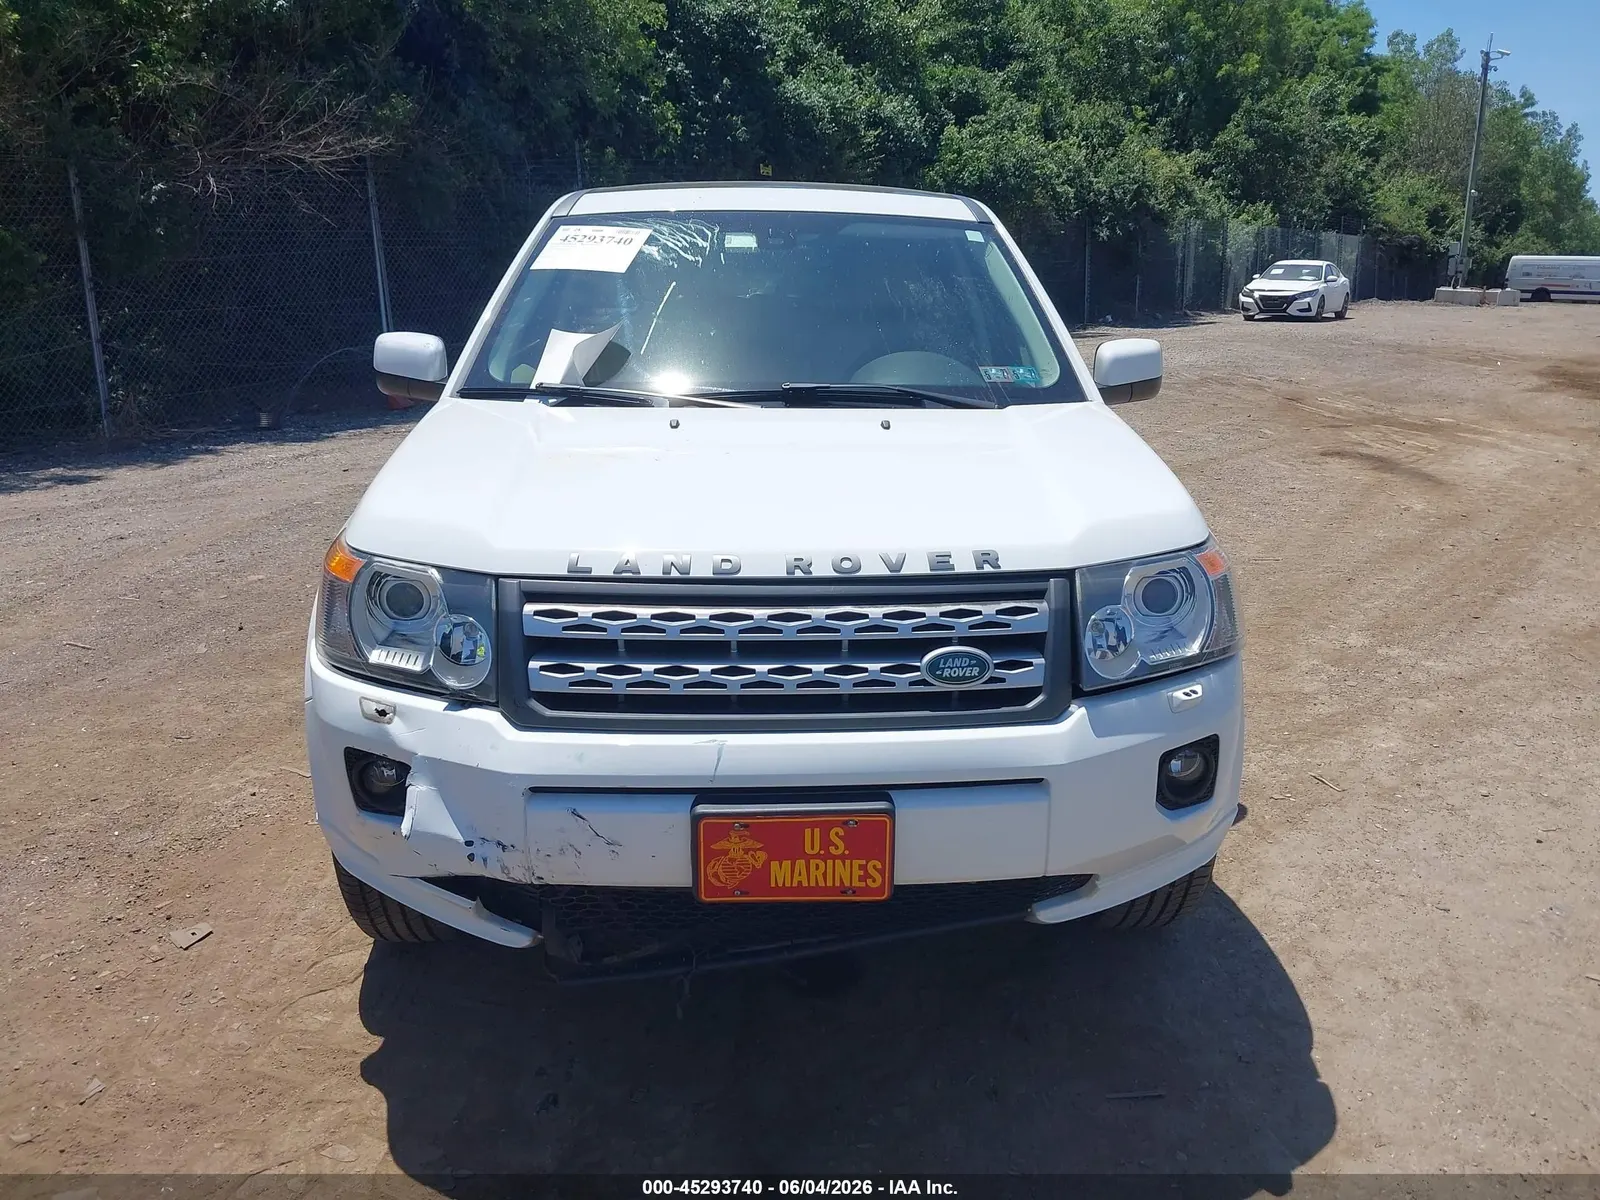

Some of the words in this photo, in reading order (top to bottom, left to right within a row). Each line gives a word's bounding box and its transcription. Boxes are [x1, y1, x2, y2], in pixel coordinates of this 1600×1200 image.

[559, 234, 633, 245] 45293740
[567, 552, 742, 575] LAND
[785, 549, 1001, 575] ROVER
[939, 657, 969, 668] LAND
[942, 667, 979, 677] ROVER
[804, 827, 849, 855] U.S.
[770, 859, 882, 888] MARINES
